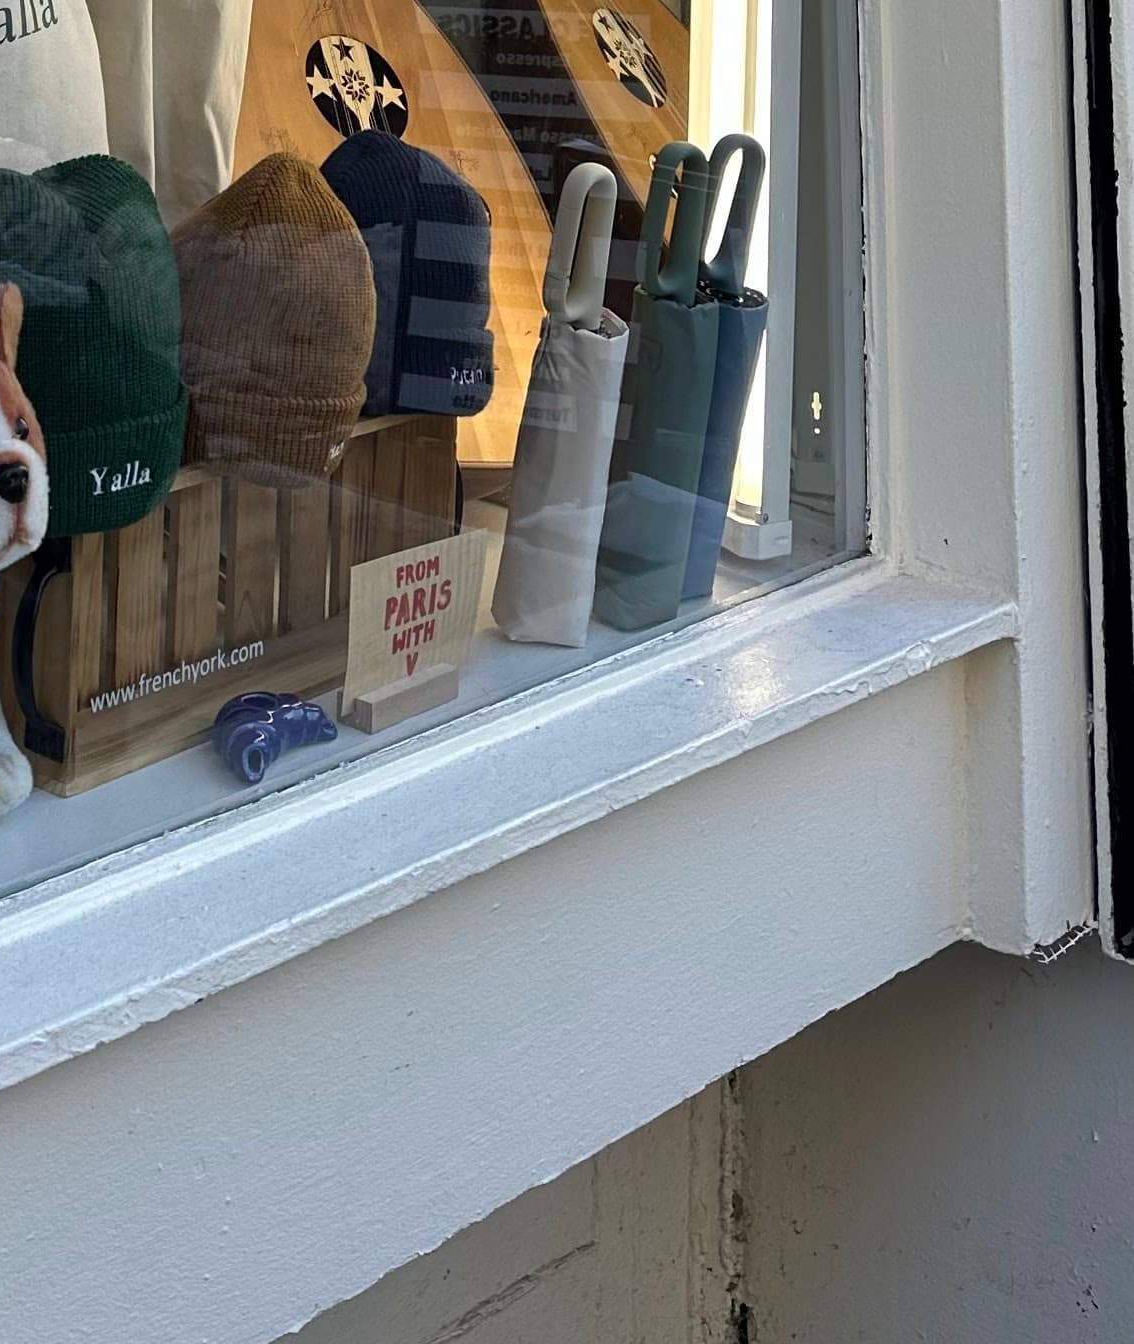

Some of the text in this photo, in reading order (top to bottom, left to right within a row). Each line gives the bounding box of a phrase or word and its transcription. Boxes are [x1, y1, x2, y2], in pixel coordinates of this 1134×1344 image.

[89, 461, 153, 496] Yalla
[395, 555, 441, 589] FROM
[384, 578, 452, 631] PARIS
[391, 618, 436, 655] WITH
[89, 638, 265, 714] www.frenchyork.com
